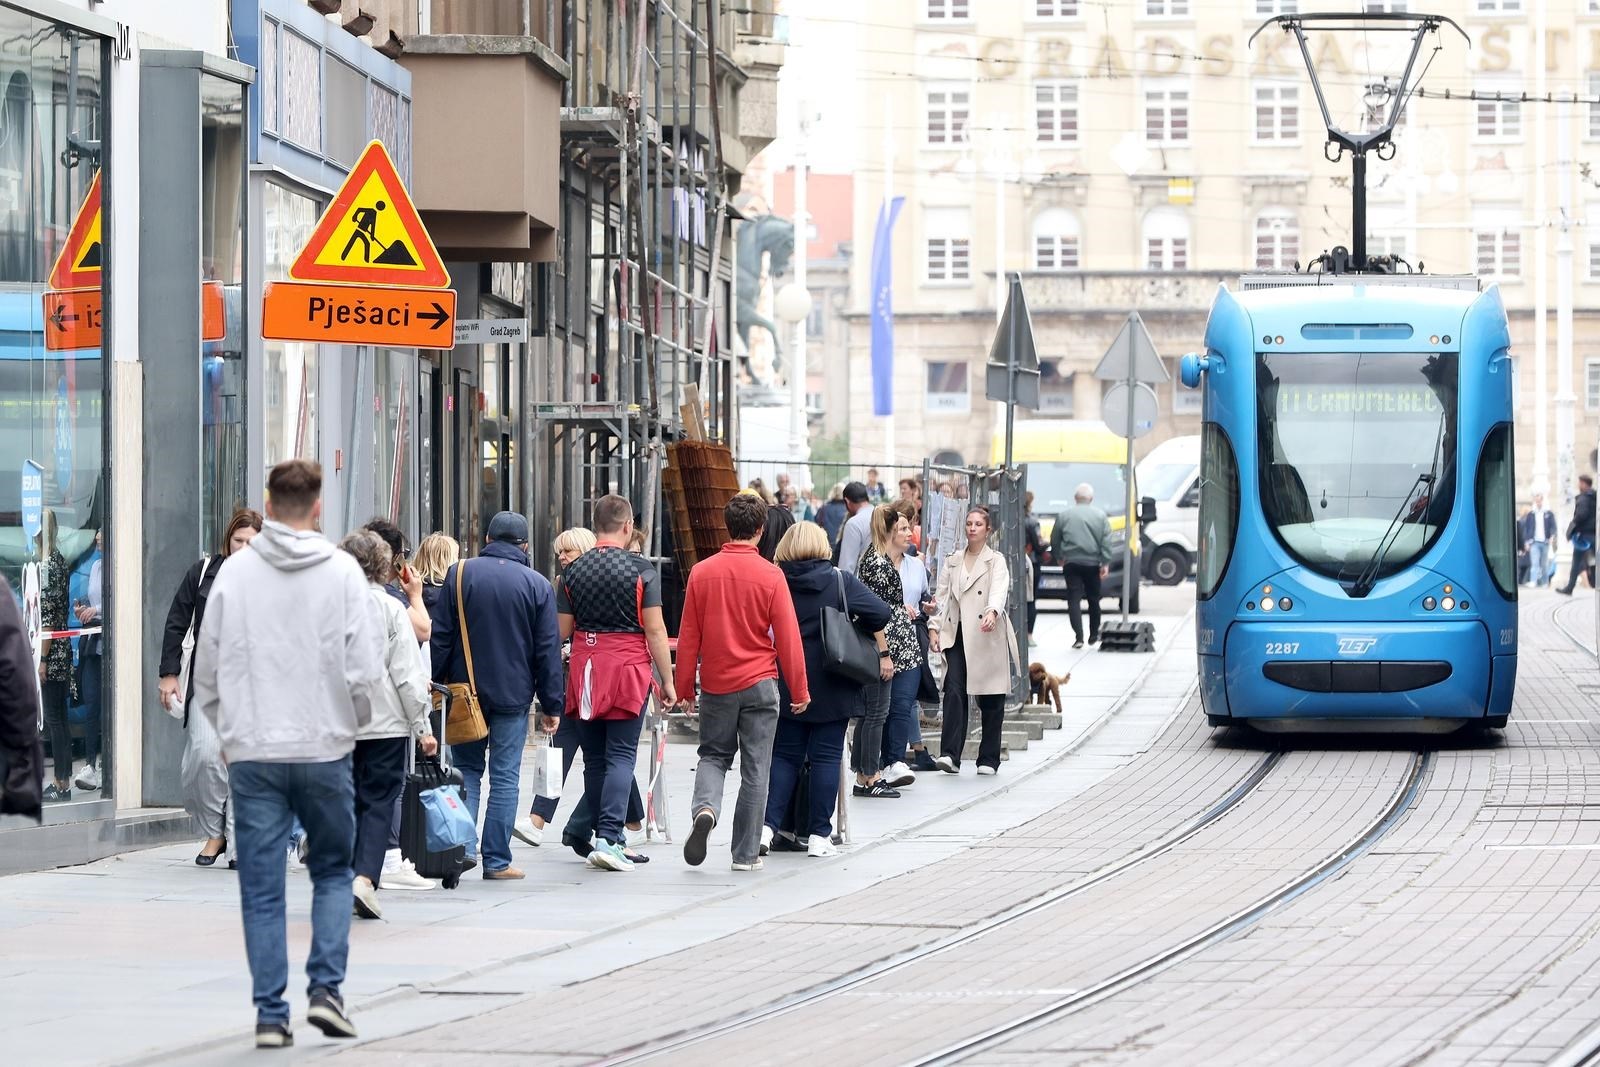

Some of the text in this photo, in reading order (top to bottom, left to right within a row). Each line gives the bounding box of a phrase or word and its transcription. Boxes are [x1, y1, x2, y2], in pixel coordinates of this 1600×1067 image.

[976, 33, 1351, 80] GRADSKA
[308, 297, 410, 329] Pješaci
[490, 326, 521, 338] Grad Zagreb
[1281, 391, 1300, 413] 11
[1265, 642, 1300, 655] 2287
[1338, 637, 1378, 654] ZET
